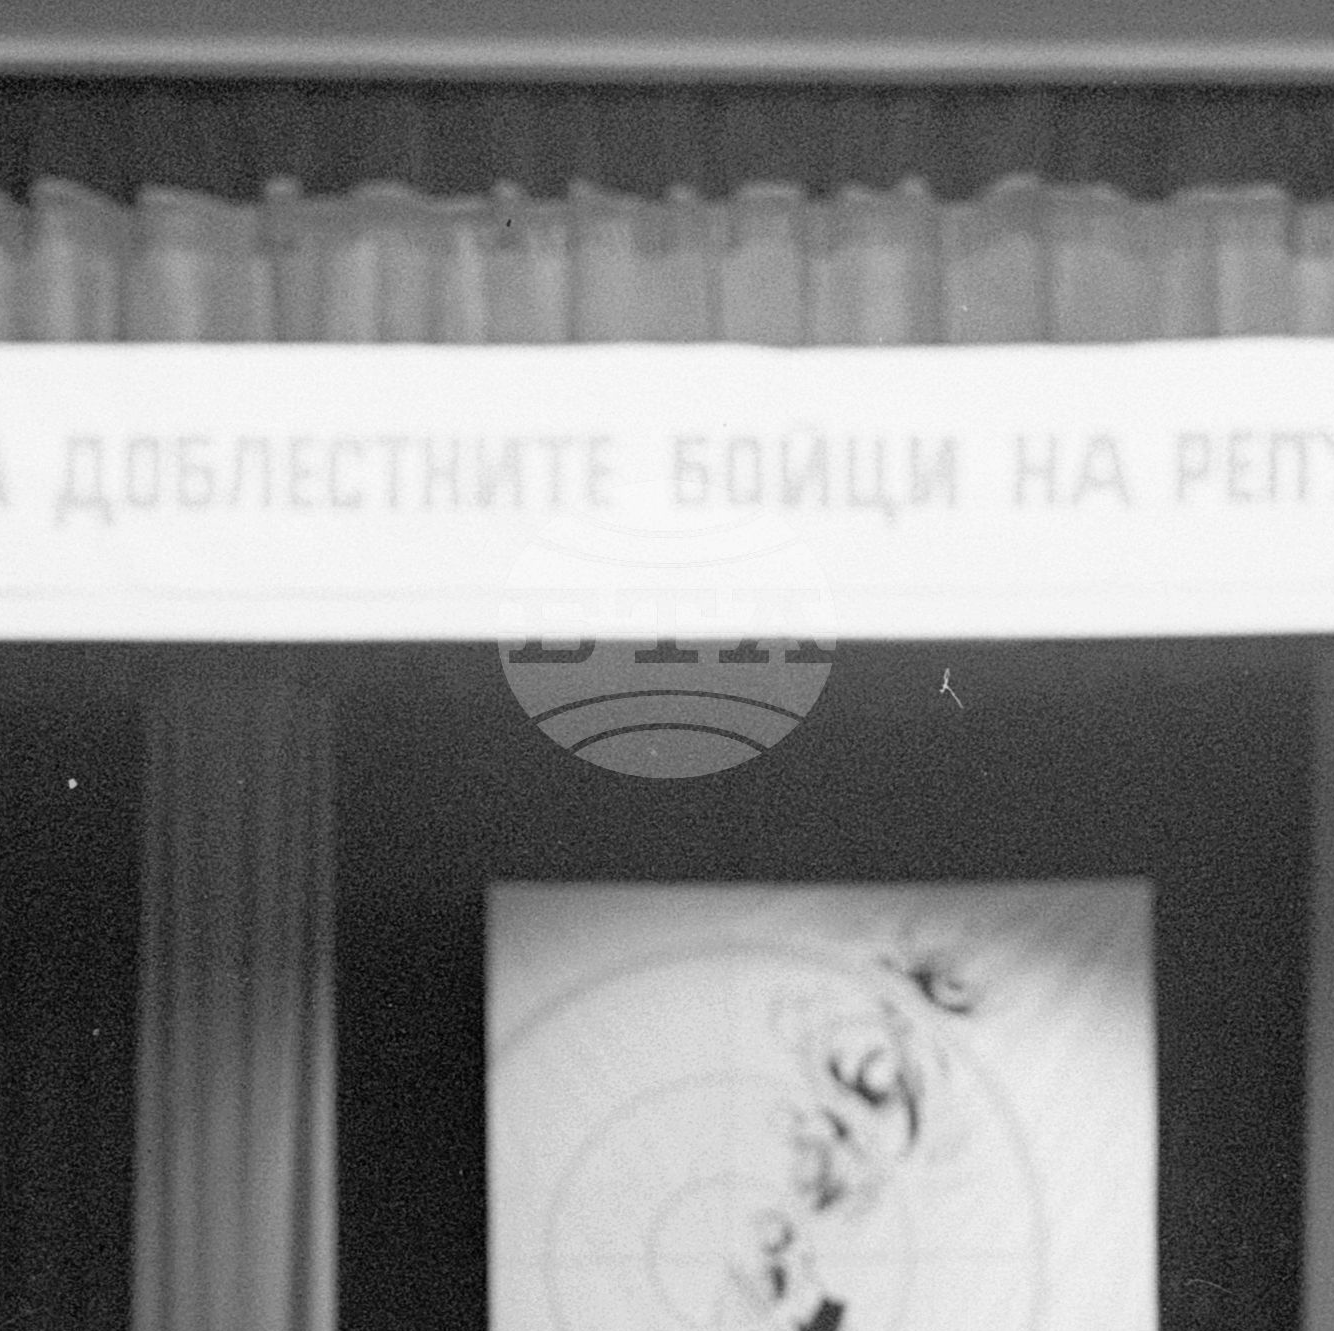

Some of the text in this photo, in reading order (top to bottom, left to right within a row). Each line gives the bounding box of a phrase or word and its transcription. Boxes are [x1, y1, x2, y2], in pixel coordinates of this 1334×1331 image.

[53, 433, 617, 527] ДОБЛЕСТНИТЕ
[670, 419, 960, 527] БОЙЦИ
[1013, 430, 1133, 508] НА
